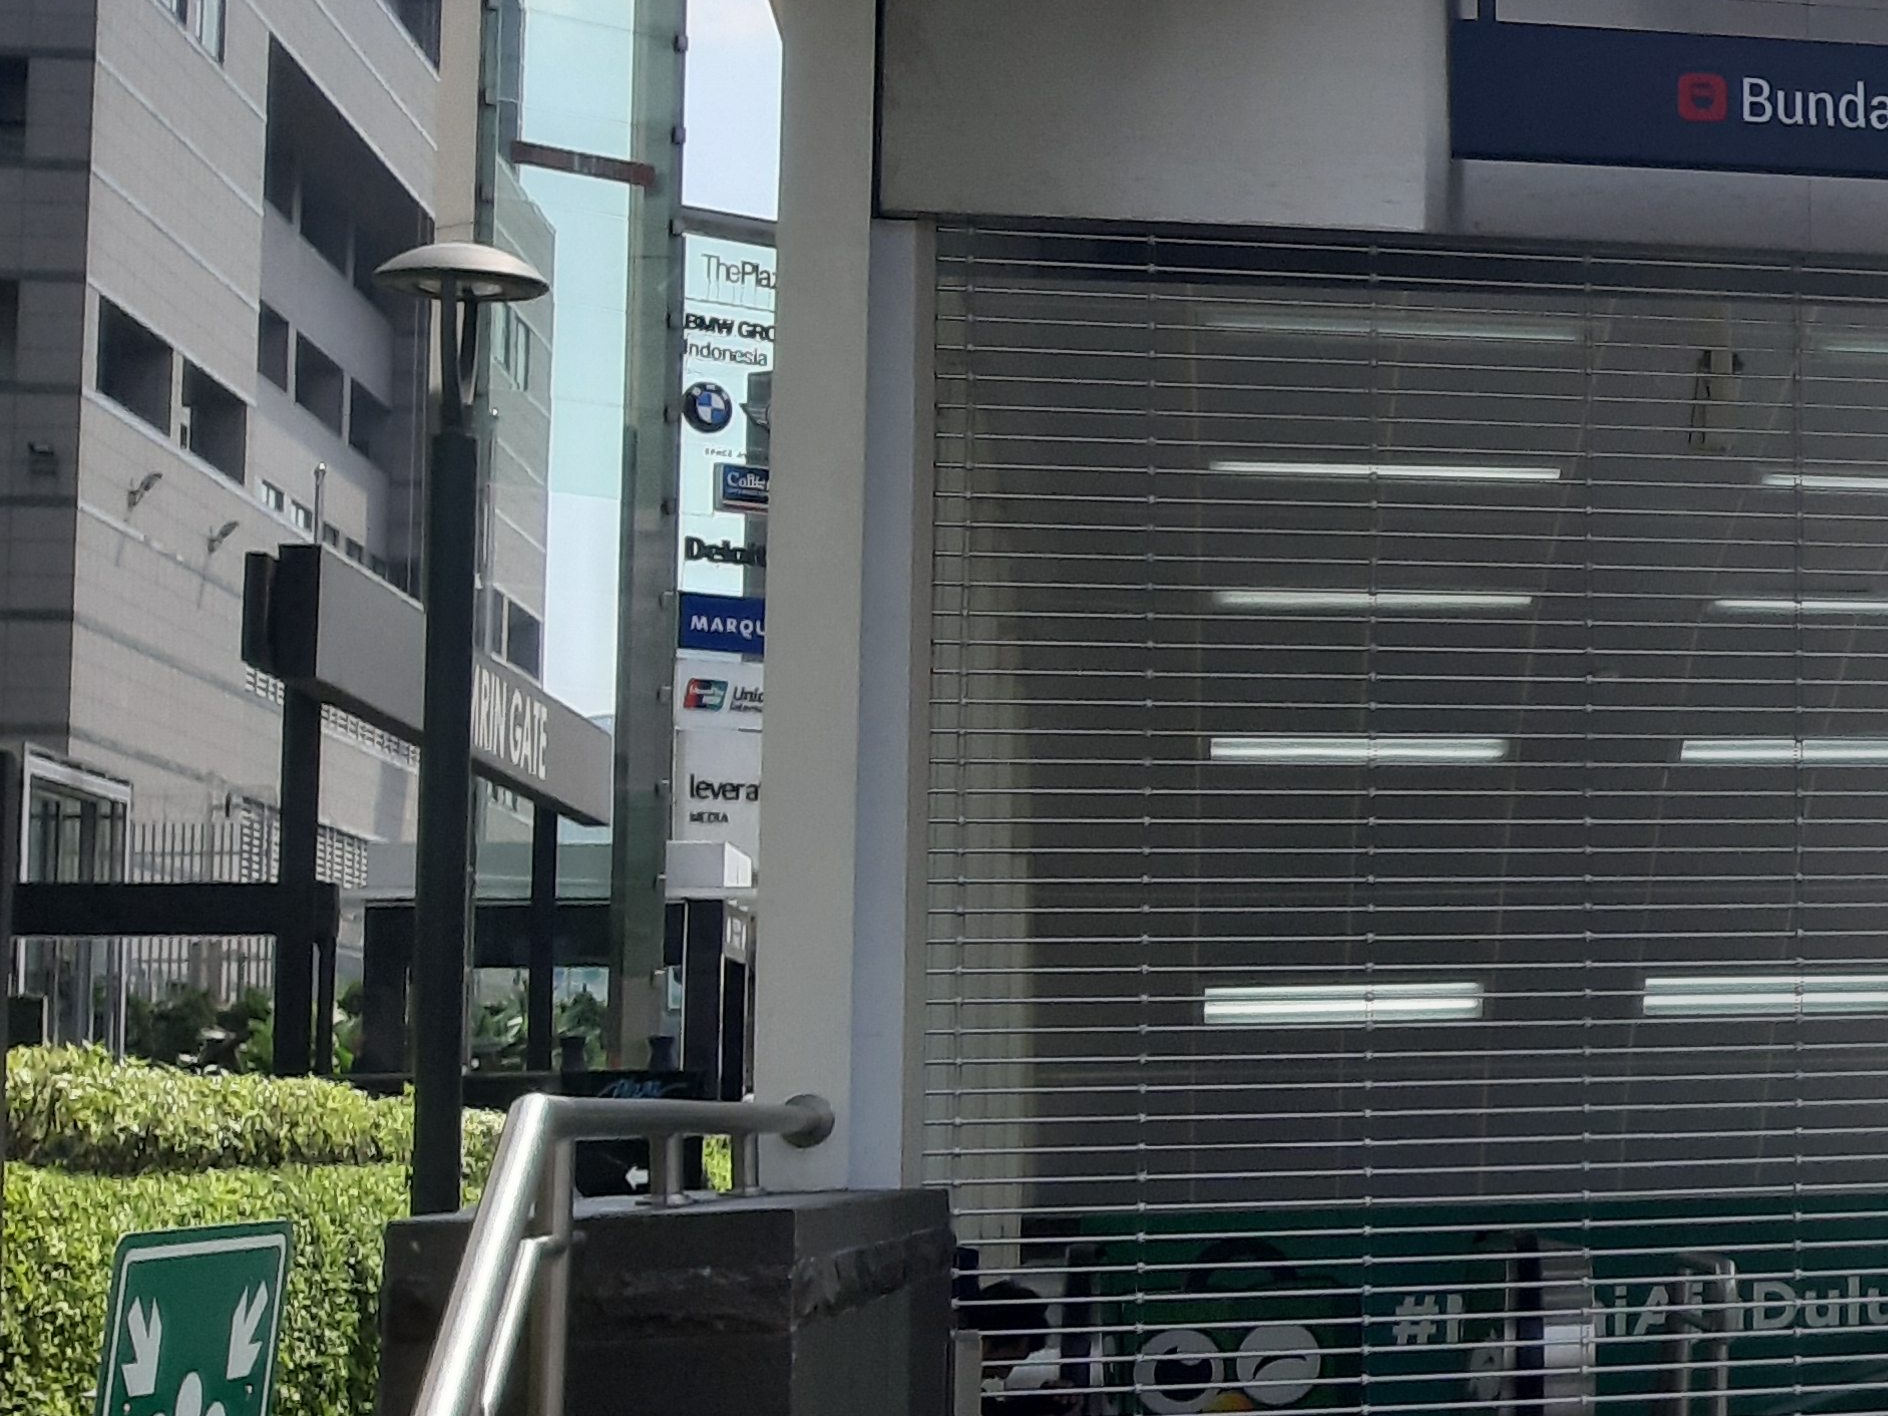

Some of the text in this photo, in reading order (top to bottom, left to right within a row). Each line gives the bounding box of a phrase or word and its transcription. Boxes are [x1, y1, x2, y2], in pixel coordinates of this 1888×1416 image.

[684, 312, 775, 342] BMW GRO
[683, 341, 768, 367] Indonesia
[690, 614, 766, 640] MARQU
[509, 687, 548, 781] GATE
[689, 773, 761, 802] levera
